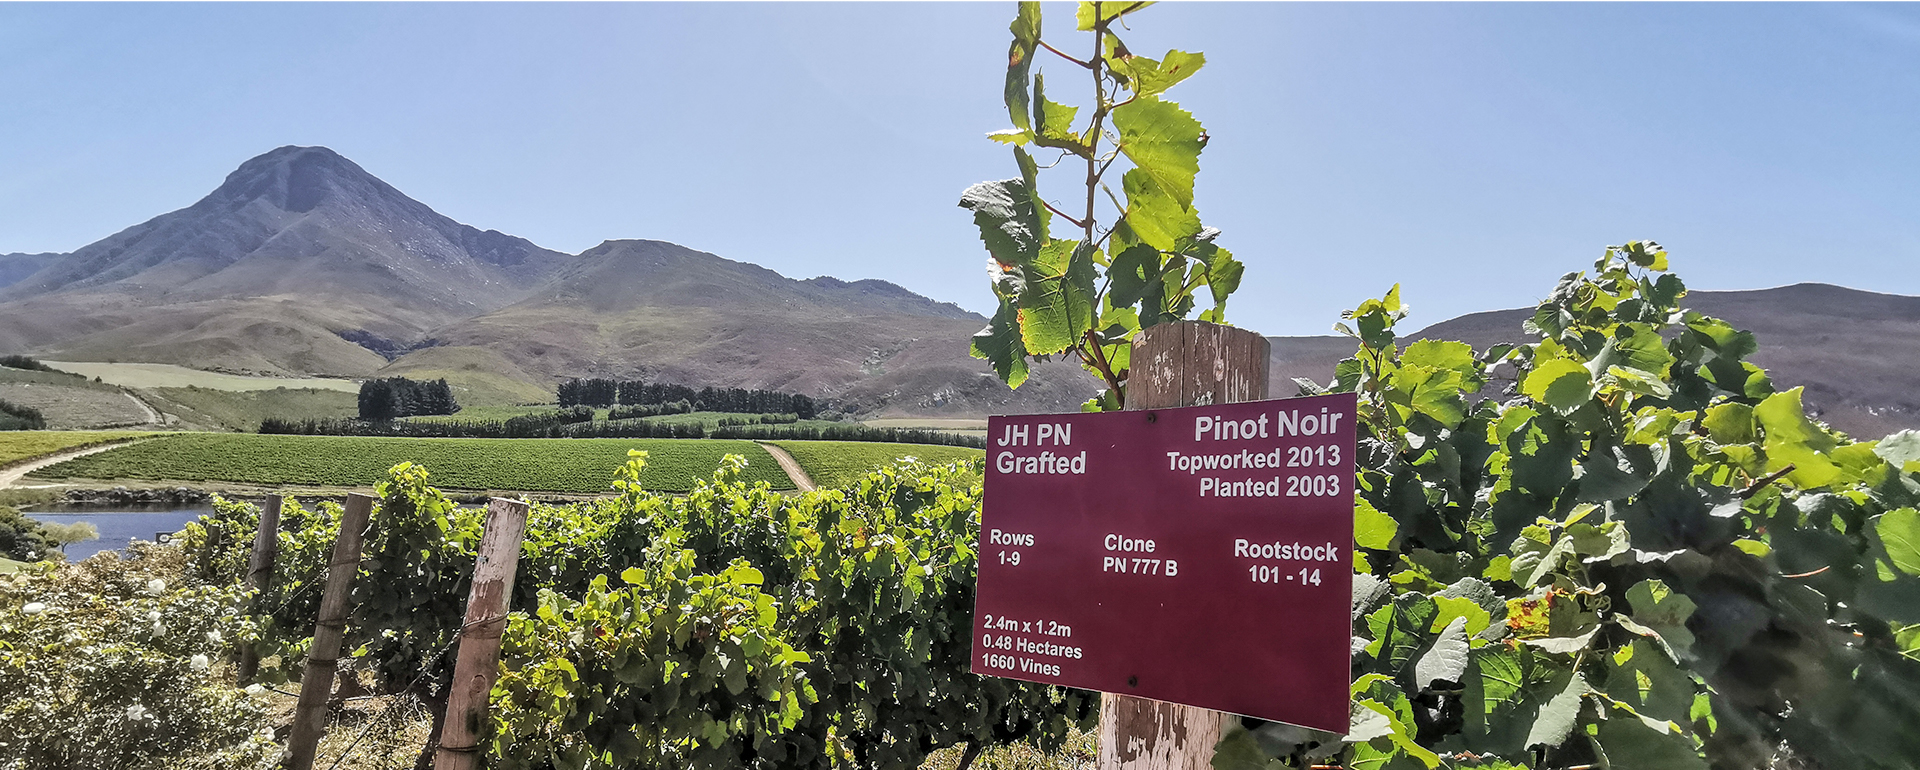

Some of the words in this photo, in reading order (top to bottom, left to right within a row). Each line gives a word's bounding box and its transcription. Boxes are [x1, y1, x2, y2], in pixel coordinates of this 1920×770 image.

[998, 425, 1028, 446] JH
[1037, 424, 1071, 445] PN
[1196, 413, 1268, 441] Pinot
[1278, 407, 1342, 437] Noir
[997, 451, 1086, 474] Grafted
[1167, 448, 1280, 474] Topworked
[1287, 445, 1340, 467] 2013
[1200, 476, 1279, 497] Planted
[1286, 475, 1339, 496] 2003
[990, 529, 1034, 546] Rows
[1105, 534, 1155, 552] Clone
[998, 551, 1021, 566] 1-9
[1235, 539, 1338, 561] Rootstock
[1104, 557, 1126, 573] PN
[1132, 559, 1160, 575] 777
[1166, 560, 1177, 576] B
[1249, 565, 1278, 583] 101
[1299, 568, 1321, 586] 14
[984, 615, 1018, 631] 2.4m
[1022, 622, 1031, 632] x
[1036, 620, 1071, 637] 1.2m
[983, 634, 1012, 650] 0.48
[1016, 637, 1082, 659] Hectares
[982, 653, 1015, 670] 1660
[1020, 658, 1060, 676] Vines
